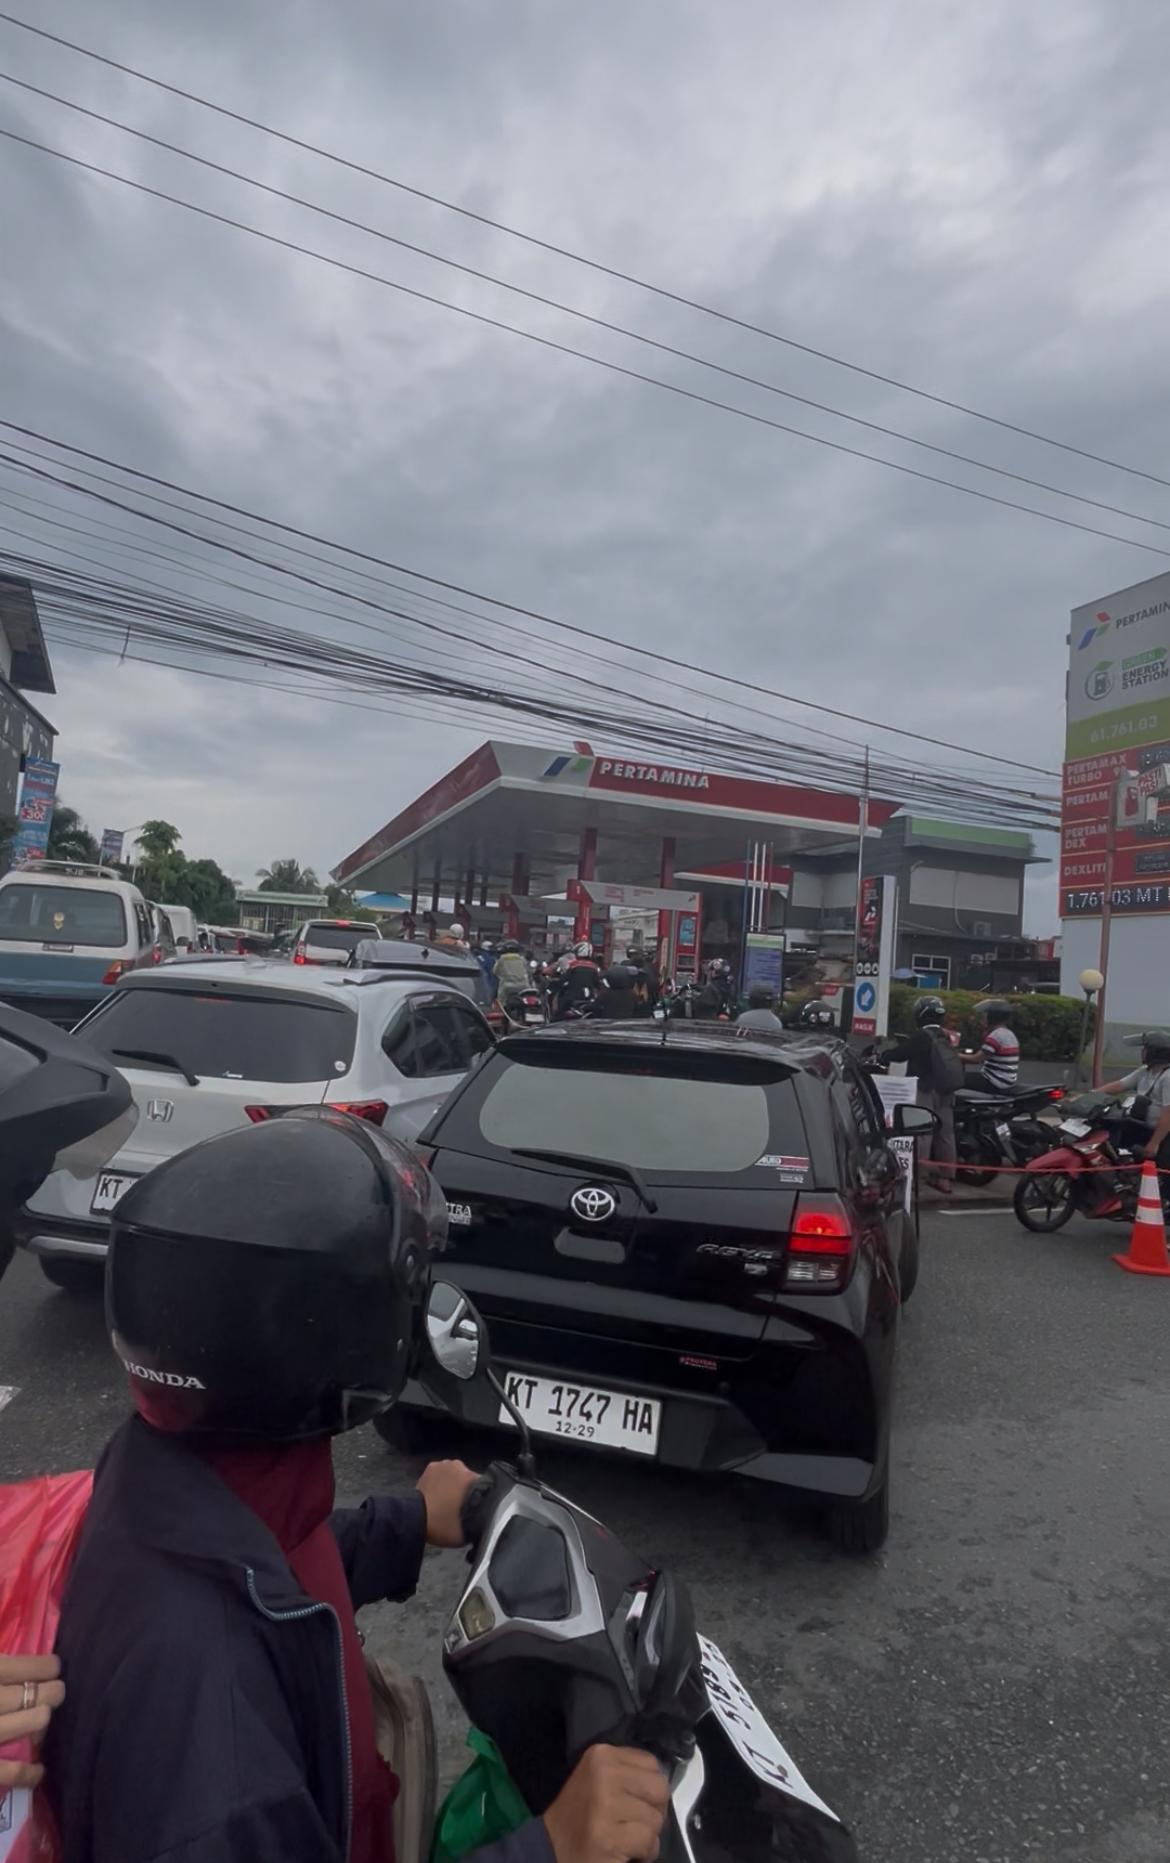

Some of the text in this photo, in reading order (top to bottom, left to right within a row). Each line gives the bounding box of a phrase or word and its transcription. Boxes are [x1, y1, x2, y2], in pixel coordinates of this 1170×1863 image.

[1121, 668, 1169, 690] STATION
[1122, 660, 1167, 682] ENERGY
[600, 761, 710, 789] PERTAMINA
[1067, 753, 1127, 776] PERTAMAX
[1067, 770, 1103, 786] TURBO
[1066, 790, 1109, 807] PERTAM
[1065, 823, 1108, 839] PERTAM
[1065, 837, 1087, 850] DEX
[1137, 886, 1164, 903] MT
[99, 1177, 124, 1199] KT
[445, 1202, 472, 1219] TRA
[123, 1359, 207, 1390] HONDA
[507, 1376, 653, 1435] KT 1747 HA
